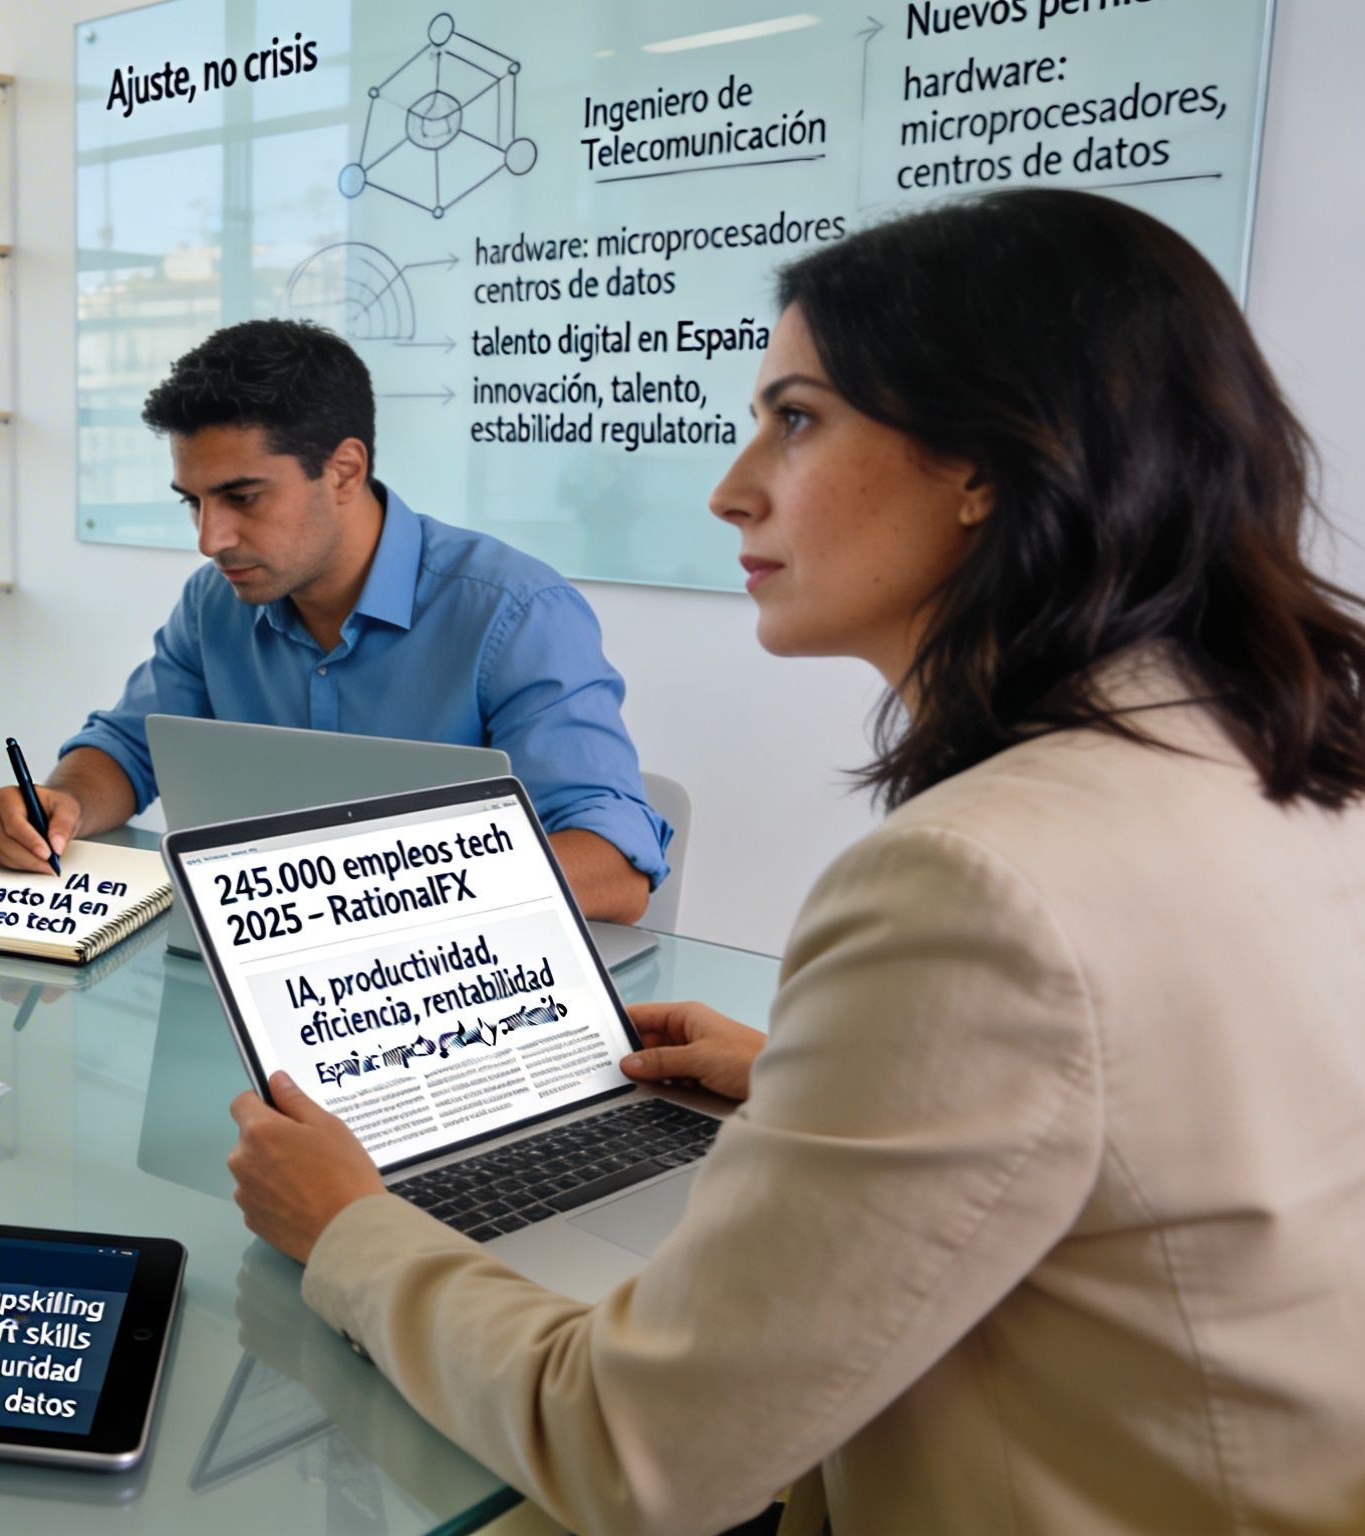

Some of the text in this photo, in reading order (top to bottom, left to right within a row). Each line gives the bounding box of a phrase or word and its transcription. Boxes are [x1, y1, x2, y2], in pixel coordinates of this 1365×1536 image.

[907, 0, 1027, 39] Nuevos
[106, 32, 319, 118] Ajuste, no crisis
[903, 56, 1067, 101] hardware:
[584, 75, 753, 131] Ingeniero de
[901, 81, 1228, 146] microprocesadores,
[581, 111, 827, 171] Telecomunicación
[897, 136, 1171, 190] centros de datos
[475, 211, 847, 266] hardware: microprocesadores
[474, 266, 677, 304] centros de datos
[472, 318, 771, 361] talento digital en España
[473, 371, 708, 408] innovación, talento,
[471, 412, 737, 451] estabilidad regulatoria
[65, 873, 129, 897] IA en
[214, 855, 337, 906] 245.000
[342, 839, 454, 882] empleos
[454, 822, 515, 859] tech
[26, 912, 77, 935] tech
[49, 892, 73, 914] IA
[78, 900, 109, 917] en
[226, 902, 304, 947] 2025
[326, 869, 478, 927] RationalFX
[285, 935, 499, 1009] IA, productividad,
[300, 997, 421, 1046] eficiencia,
[23, 1322, 92, 1350] skills
[4, 1387, 78, 1418] datos
